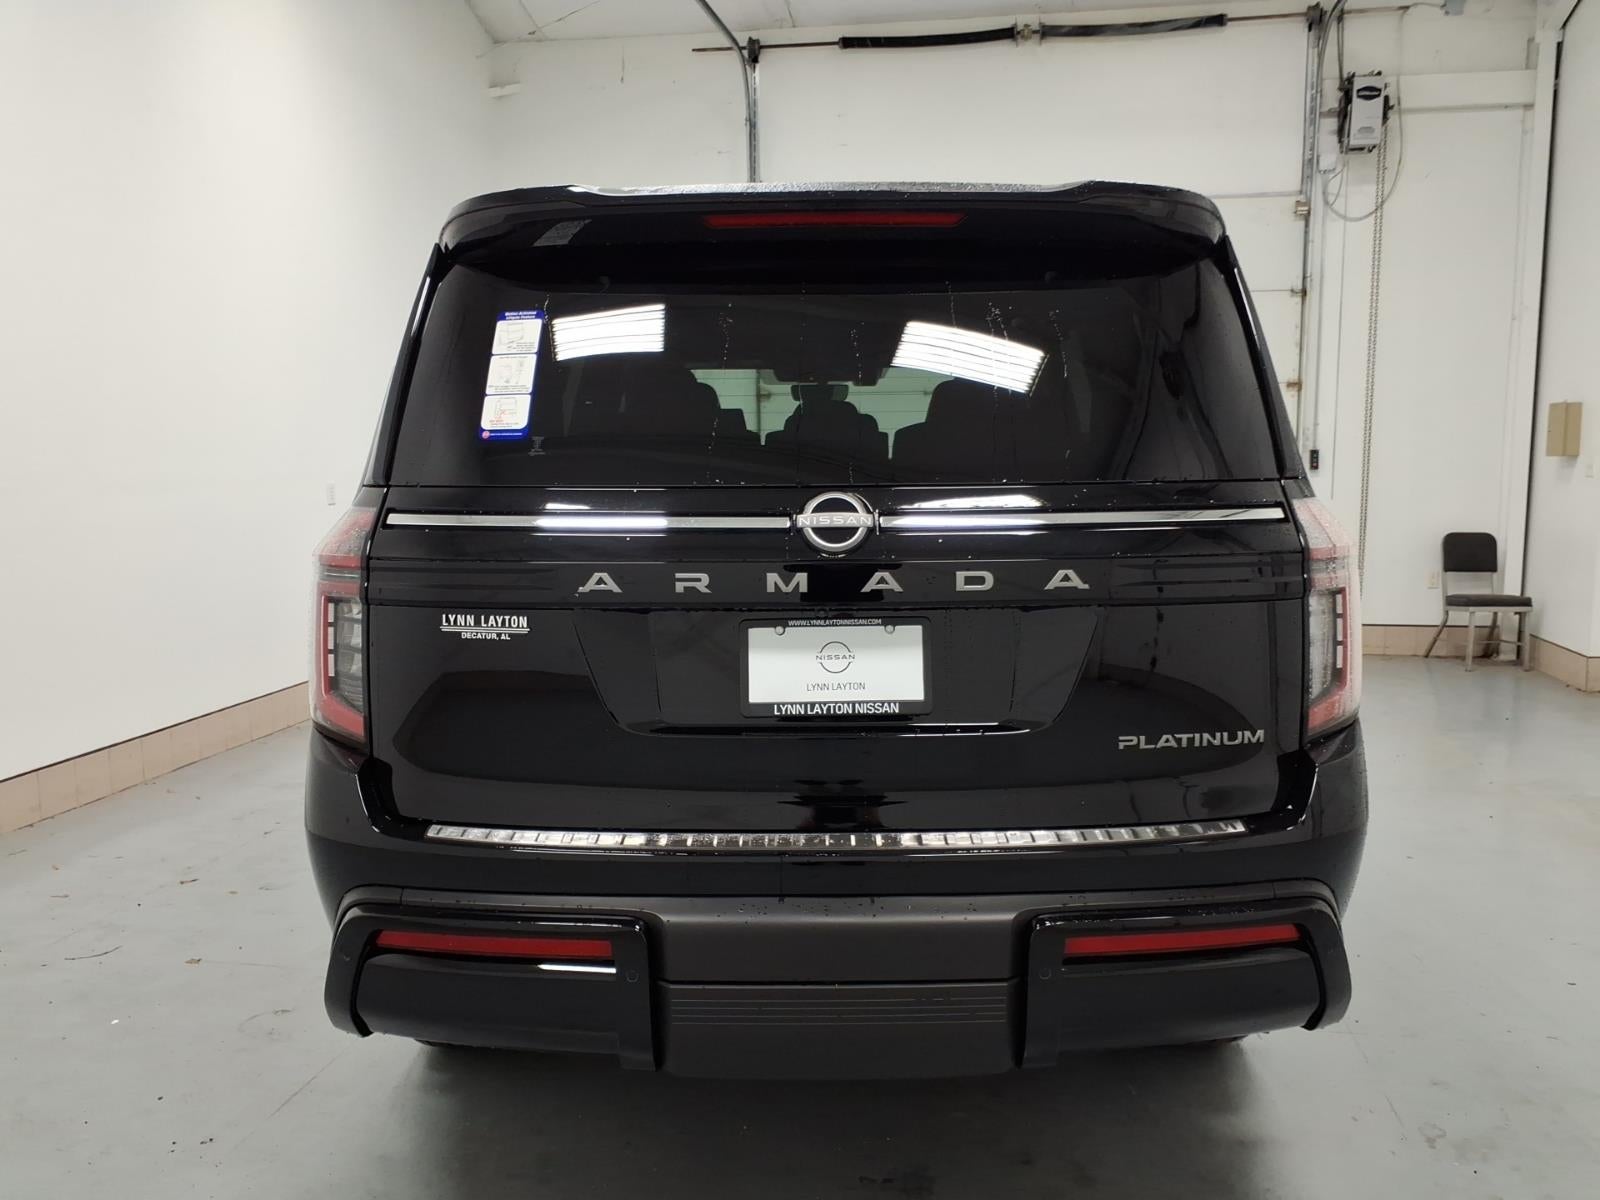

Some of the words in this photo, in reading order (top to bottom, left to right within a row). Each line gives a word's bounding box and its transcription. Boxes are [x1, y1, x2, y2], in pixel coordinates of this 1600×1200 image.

[799, 516, 872, 526] NISSAN
[578, 568, 1090, 594] ARMADA
[442, 614, 475, 627] LYNN
[481, 615, 528, 628] LAYTON
[788, 618, 882, 627] WWW.LYNNLAYTONNISSAN.COM
[461, 632, 499, 640] DECATUR,
[806, 683, 829, 692] LYNN
[831, 682, 866, 691] LAYTON
[774, 704, 805, 715] LYNN
[807, 703, 853, 715] LAYTON
[855, 702, 899, 714] NISSAN
[1118, 729, 1265, 750] PLATINUM
